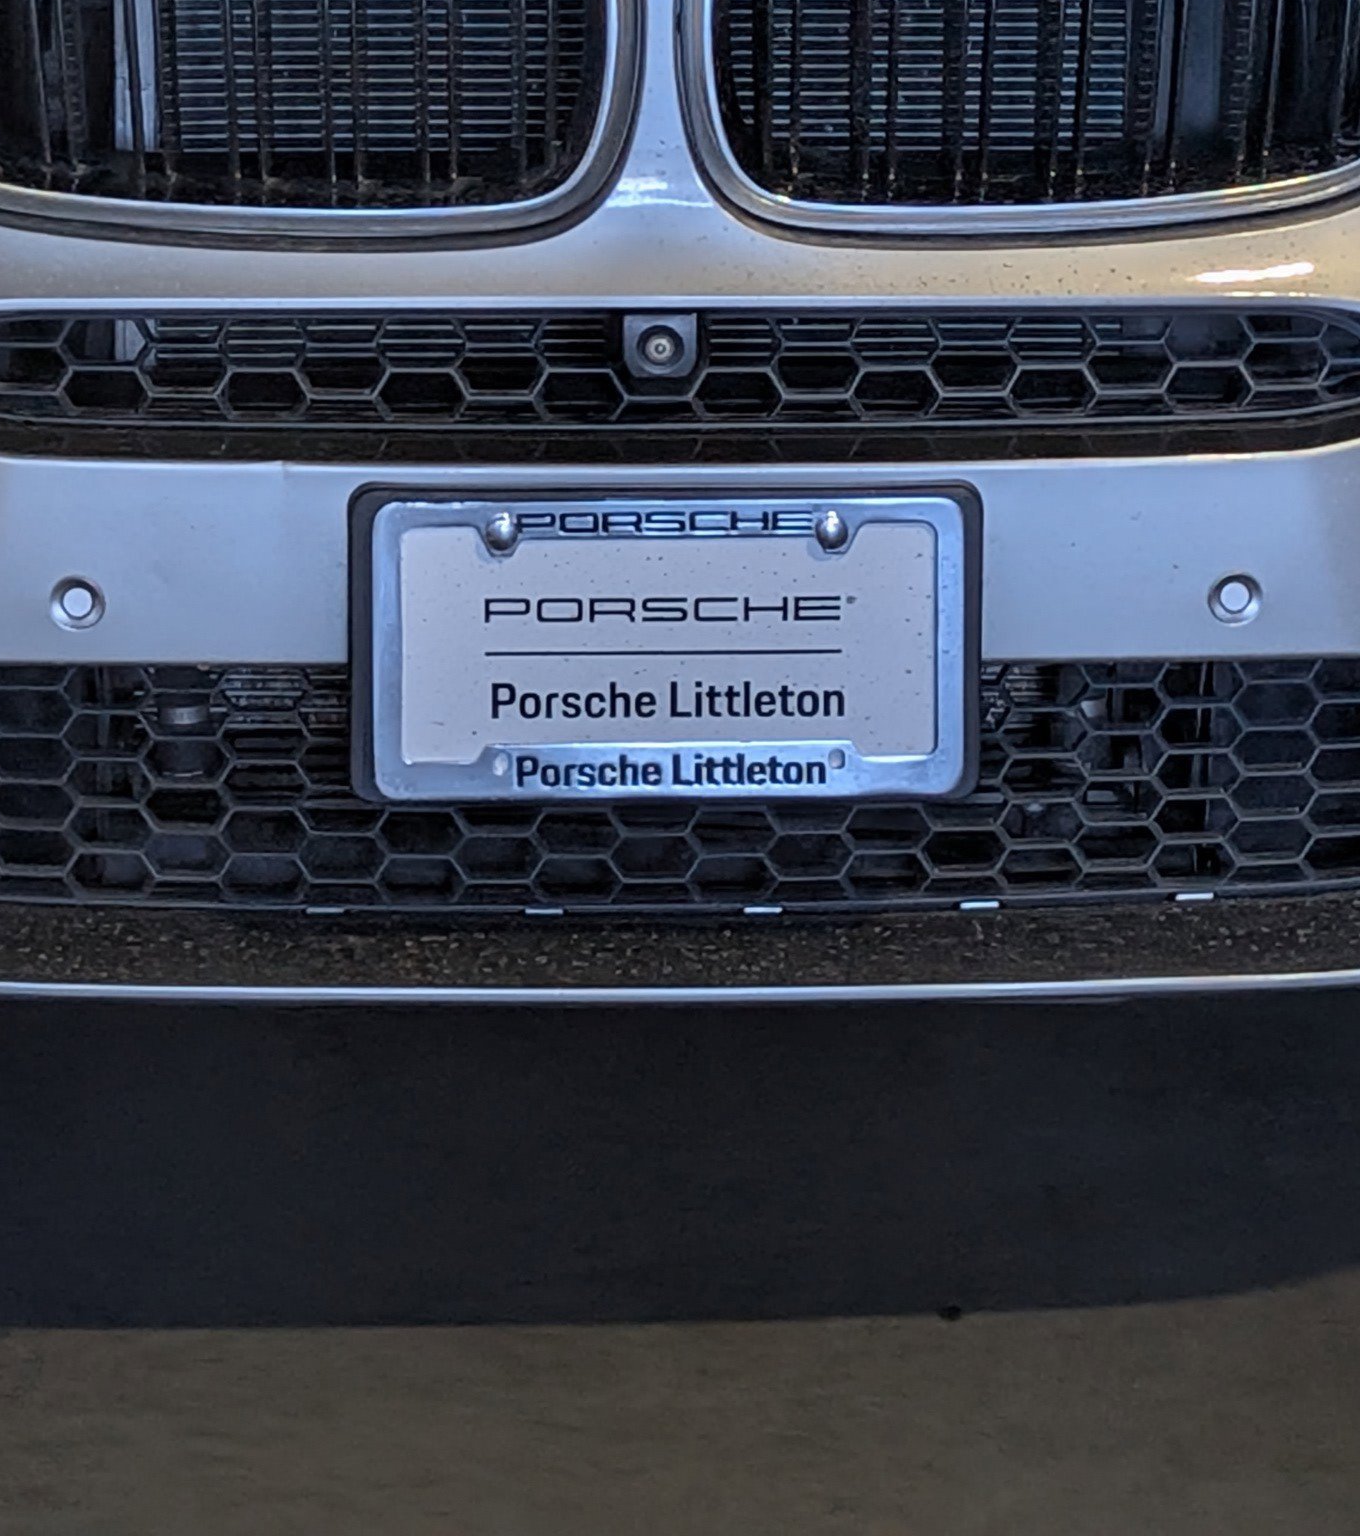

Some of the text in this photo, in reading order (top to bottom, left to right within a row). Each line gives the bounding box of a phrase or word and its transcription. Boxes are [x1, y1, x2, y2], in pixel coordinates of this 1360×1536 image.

[515, 510, 814, 535] PORSCHE
[483, 596, 841, 623] PORSCHE
[490, 680, 845, 720] Porsche Littleton
[515, 753, 827, 787] Porsche Littleton
